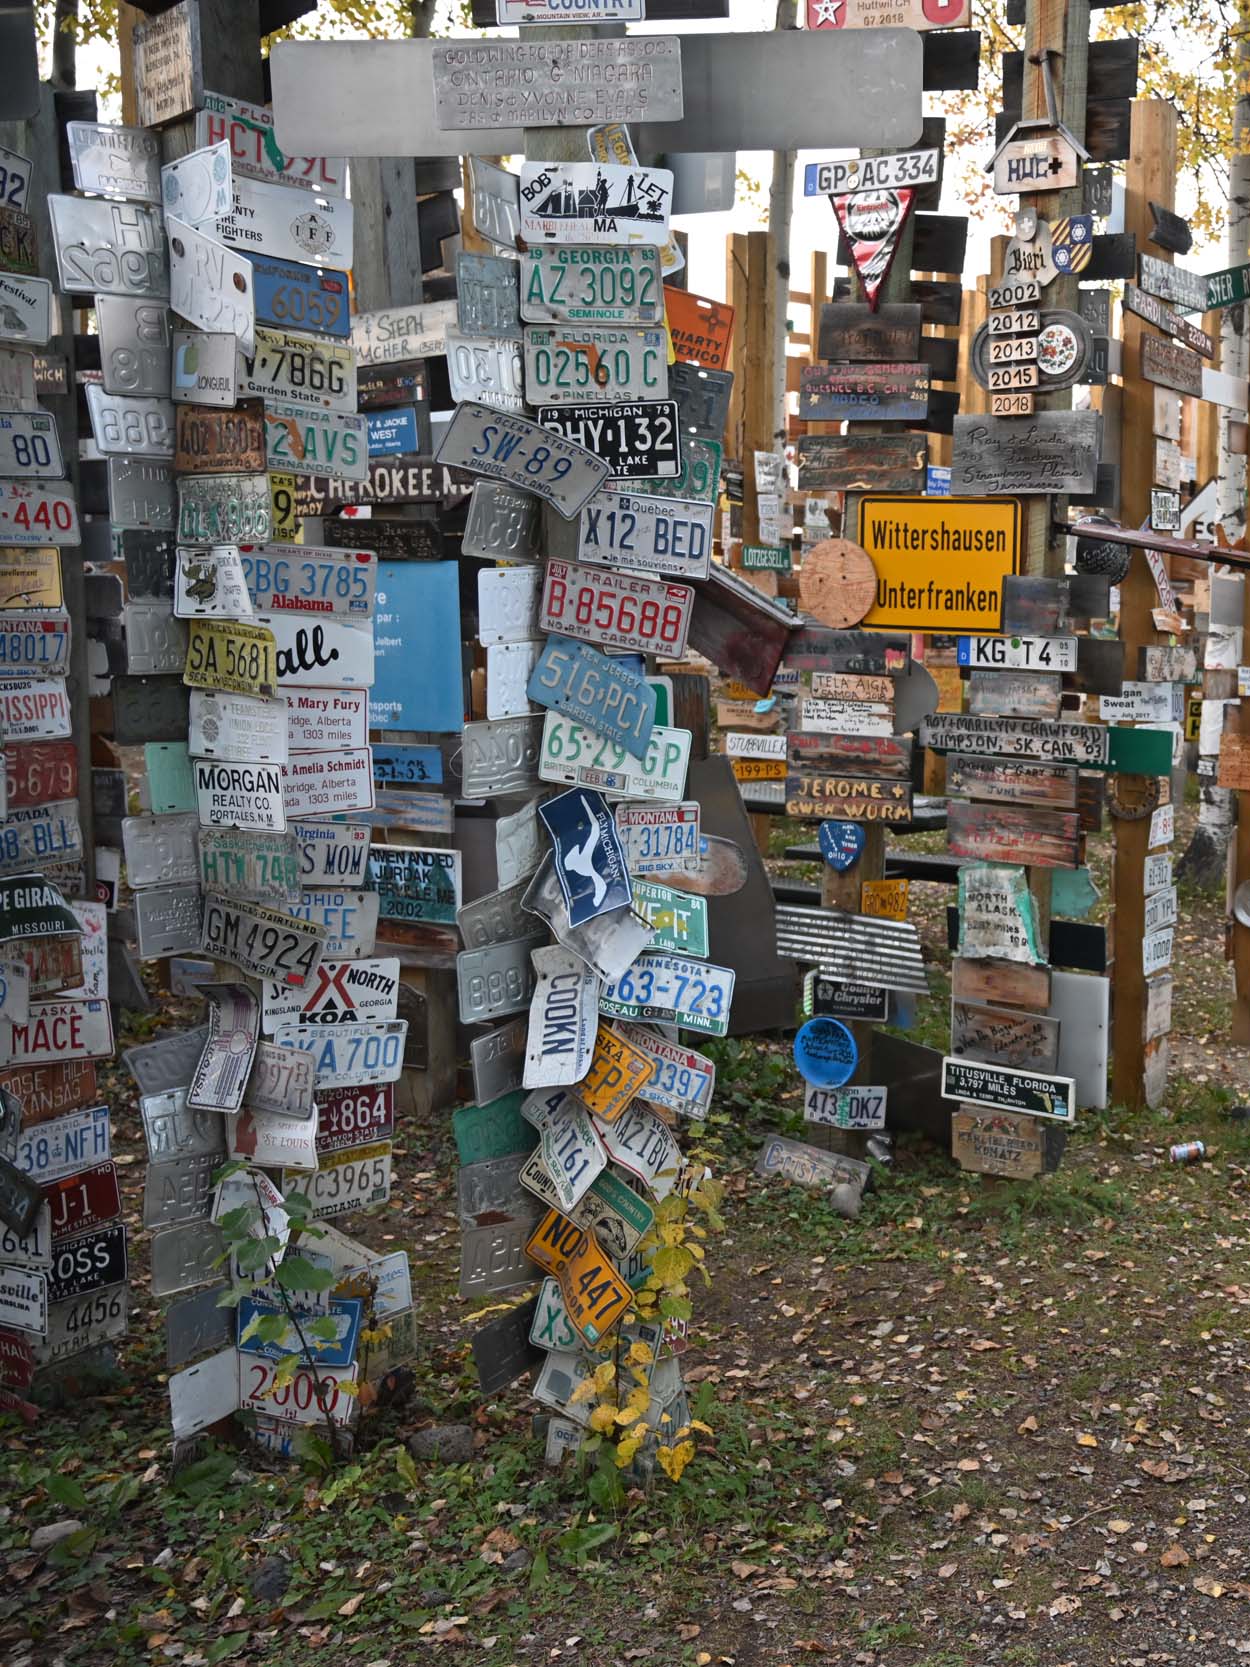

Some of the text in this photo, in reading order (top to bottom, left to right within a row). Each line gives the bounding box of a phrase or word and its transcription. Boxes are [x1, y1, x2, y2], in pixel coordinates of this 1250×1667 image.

[818, 154, 935, 191] GP AC 334
[521, 172, 552, 203] BOB
[636, 176, 669, 203] LET
[216, 223, 263, 242] FIGHTERS
[593, 218, 618, 233] MA
[558, 251, 632, 265] GEORGIA
[1009, 247, 1047, 275] Bieri
[527, 264, 656, 305] AZ 3092
[991, 284, 1037, 307] 2002
[272, 285, 340, 327] 6059
[568, 309, 625, 320] SEMINOLE
[991, 312, 1037, 332] 2012
[562, 333, 630, 345] FLORIDA
[993, 339, 1034, 359] 2013
[642, 350, 659, 387] C
[991, 366, 1032, 387] 2015
[198, 375, 231, 392] LONGUEUIL
[248, 381, 321, 403] Garden State
[562, 391, 633, 401] PINELLAS
[994, 396, 1030, 413] 2018
[574, 406, 643, 419] MICHIGAN
[371, 429, 397, 440] WEST
[304, 426, 358, 465] AVS
[472, 424, 574, 483] SW-89
[619, 456, 649, 466] LAKE
[631, 502, 676, 517] Quebec
[584, 507, 706, 560] X12 BED
[872, 519, 1006, 552] Wittershausen
[300, 563, 370, 599] 3785
[583, 571, 651, 594] TRAILER
[271, 593, 335, 612] Alabama
[877, 578, 998, 613] Unterfranken
[600, 632, 674, 654] CAROLINA
[976, 638, 1052, 664] KG T 4
[190, 635, 269, 683] SA 5681
[602, 661, 642, 689] JERSEY
[298, 698, 361, 713] Mary Fury
[1103, 699, 1135, 709] Sweat
[317, 717, 352, 727] Alberta
[559, 702, 598, 730] GARDEN
[303, 730, 352, 740] 1303 miles
[292, 760, 366, 777] Amelia Schmidt
[199, 768, 280, 794] MORGAN
[321, 780, 356, 791] Alberta
[632, 777, 679, 792] COLUMBIA
[798, 778, 882, 798] JEROME
[212, 794, 272, 810] REALTY CO.
[333, 793, 358, 803] miles
[629, 812, 679, 825] MONTANA
[843, 802, 912, 822] WURM
[294, 826, 336, 840] Virginia
[640, 824, 695, 859] 31784
[11, 921, 65, 935] MISSOURI
[207, 909, 320, 977] GM 4924
[634, 957, 703, 977] MINNESOTA
[346, 968, 396, 995] NORTH
[617, 970, 725, 1018] 63-723
[264, 998, 393, 1017] KINGSLAND GEORGIA
[300, 1010, 358, 1024] KOA
[682, 1014, 712, 1029] MINN.
[11, 1015, 85, 1055] MACE
[629, 1030, 688, 1067] MONTANA
[987, 1082, 1017, 1096] MILES
[1013, 1077, 1057, 1094] FLORIDA
[808, 1092, 883, 1119] 473 DKZ
[311, 1198, 362, 1218] INDIANA
[578, 1267, 624, 1321] 447
[66, 1291, 121, 1332] 4456
